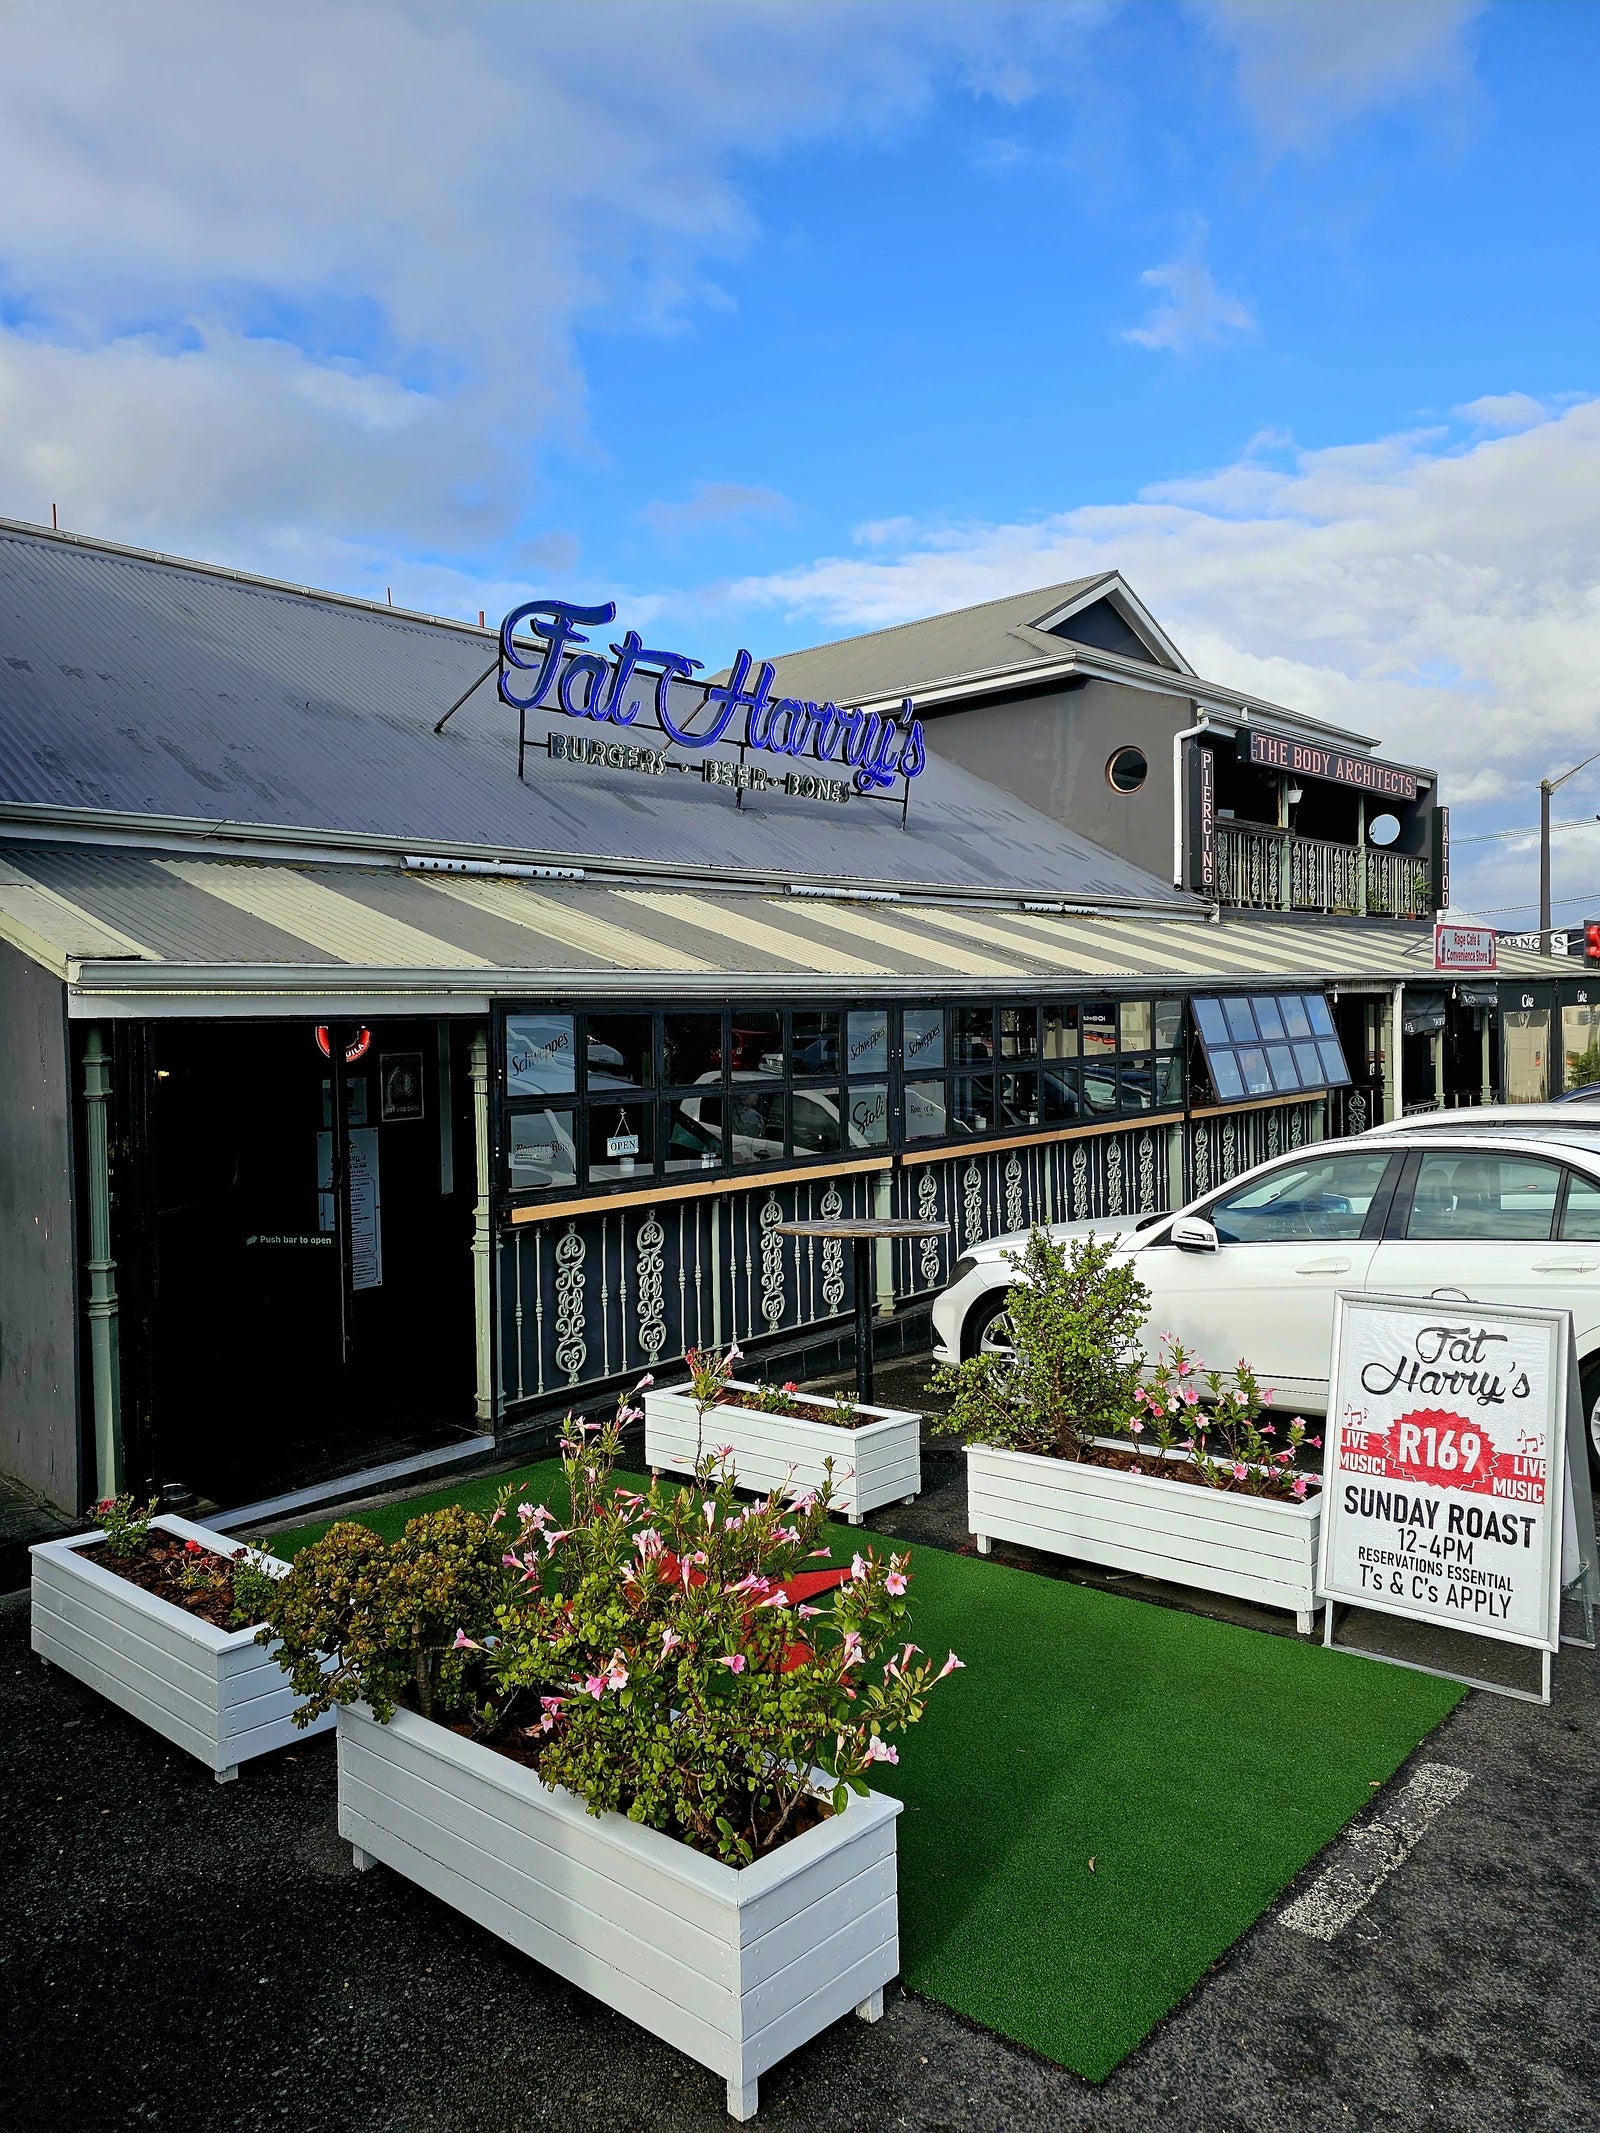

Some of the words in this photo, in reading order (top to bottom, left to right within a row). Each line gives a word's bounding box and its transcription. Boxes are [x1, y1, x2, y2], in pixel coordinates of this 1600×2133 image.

[498, 600, 700, 726] Fat
[655, 649, 927, 790] Harry's
[548, 731, 668, 775] BURGERS
[702, 758, 768, 791] BEER
[785, 771, 852, 803] BONES
[1257, 736, 1288, 766] THE
[1294, 745, 1331, 776] BODY
[1336, 756, 1414, 796] ARCHITECTS
[1202, 752, 1213, 884] PIERCING
[1446, 948, 1476, 962] Convenience
[1476, 950, 1488, 962] Store
[851, 1026, 886, 1060] Schweppes
[908, 1024, 941, 1058] Schweppes
[853, 1094, 886, 1135] Stoli
[610, 1139, 637, 1152] OPEN
[260, 1235, 281, 1244] Push
[283, 1235, 297, 1244] bar
[300, 1236, 309, 1244] to
[310, 1237, 332, 1245] open
[1415, 1326, 1508, 1364] Fat
[1360, 1355, 1531, 1405] Harry's
[1340, 1428, 1369, 1451] LIVE
[1399, 1424, 1482, 1475] R169
[1339, 1451, 1386, 1476] MUSIC!
[1513, 1455, 1546, 1479] LIVE
[1344, 1485, 1440, 1530] SUNDAY
[1448, 1503, 1536, 1549] ROAST
[1397, 1527, 1474, 1565] 12-4PM
[1358, 1546, 1443, 1577] RESERVATIONS
[1447, 1564, 1514, 1592] ESSENTIAL
[1359, 1563, 1382, 1590] T's
[1389, 1571, 1404, 1596] &
[1412, 1575, 1439, 1603] C's
[1445, 1583, 1512, 1619] APPLY
